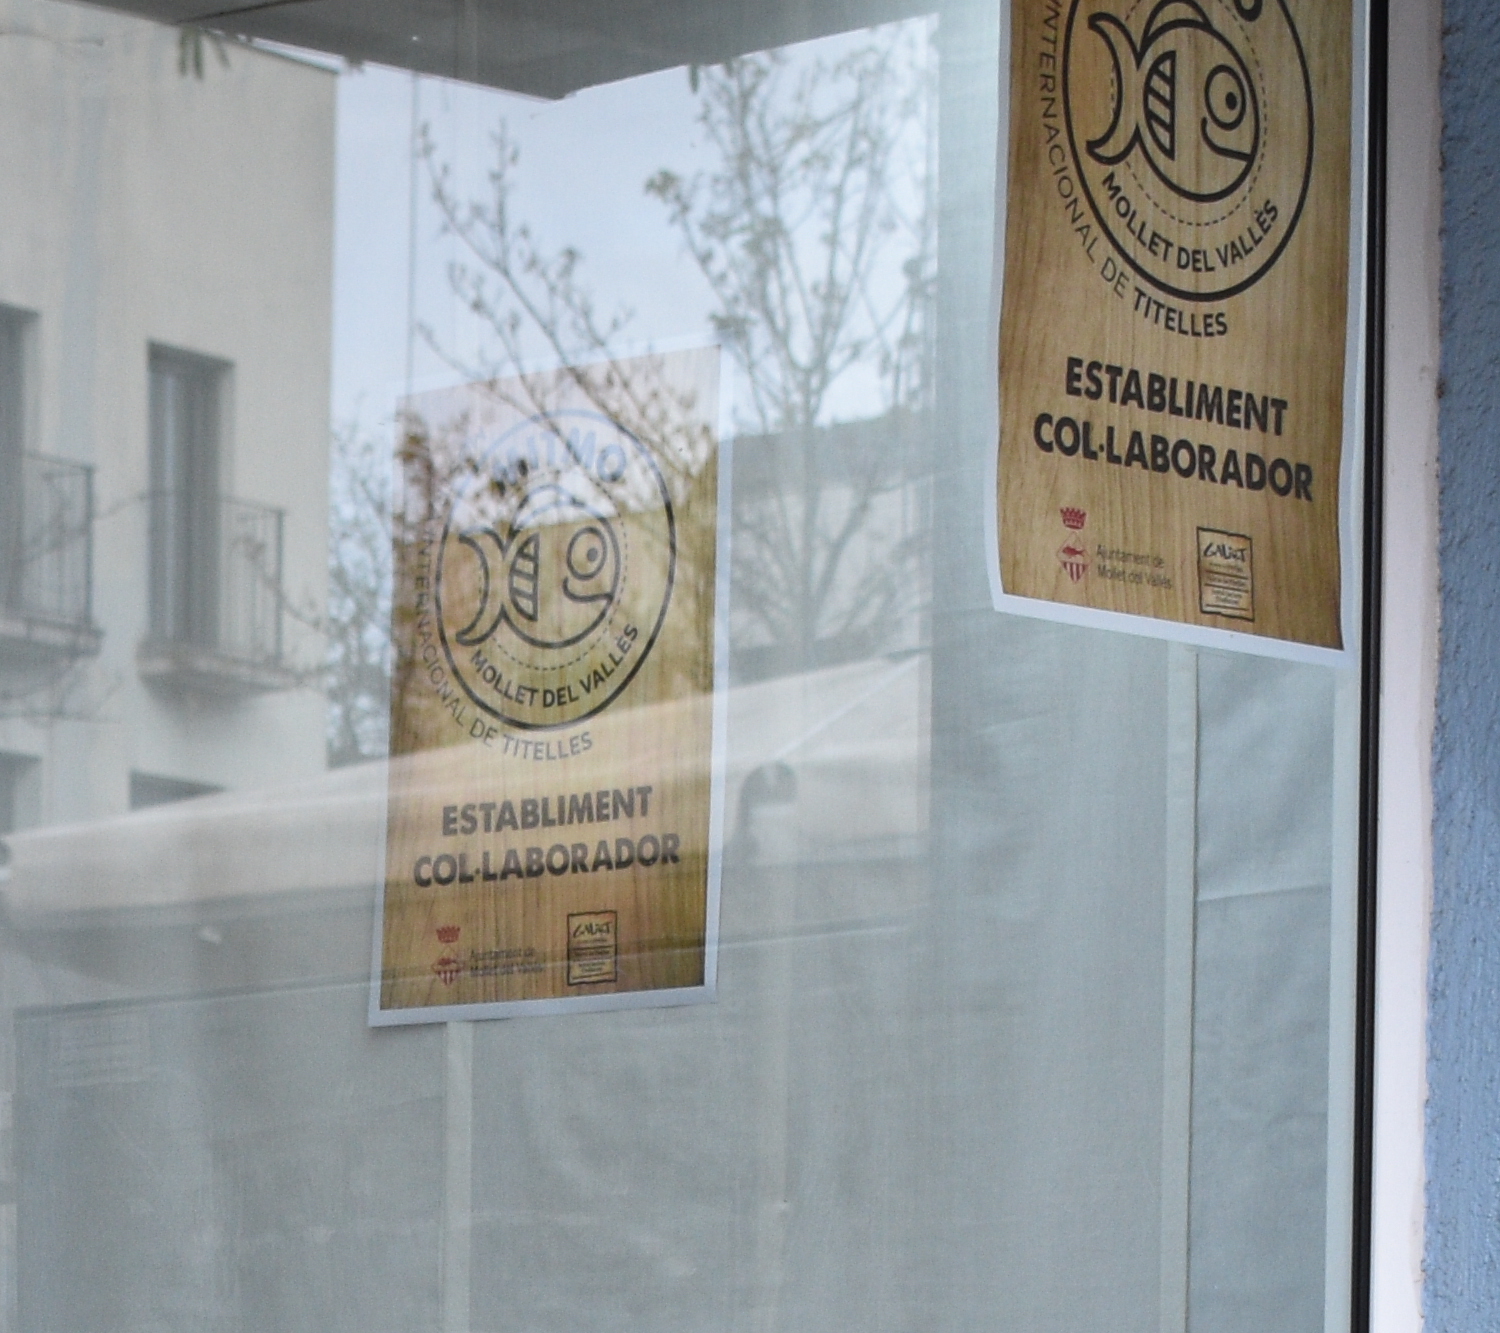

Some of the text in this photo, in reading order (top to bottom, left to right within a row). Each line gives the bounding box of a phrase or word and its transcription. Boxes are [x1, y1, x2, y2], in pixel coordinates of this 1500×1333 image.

[1102, 172, 1279, 272] MOLLET DEL VALLÈS
[1100, 256, 1130, 299] DE
[1134, 287, 1228, 337] TITELLES
[1065, 357, 1288, 437] ESTABLIMENT
[1033, 412, 1315, 502] COL·LABORADOR
[470, 623, 638, 708] MOLLET DEL VALLÈS
[470, 718, 498, 748] DE
[503, 731, 593, 761] TITELLES
[442, 786, 653, 836] ESTABLIMENT
[414, 833, 681, 887] COL·LABORADOR
